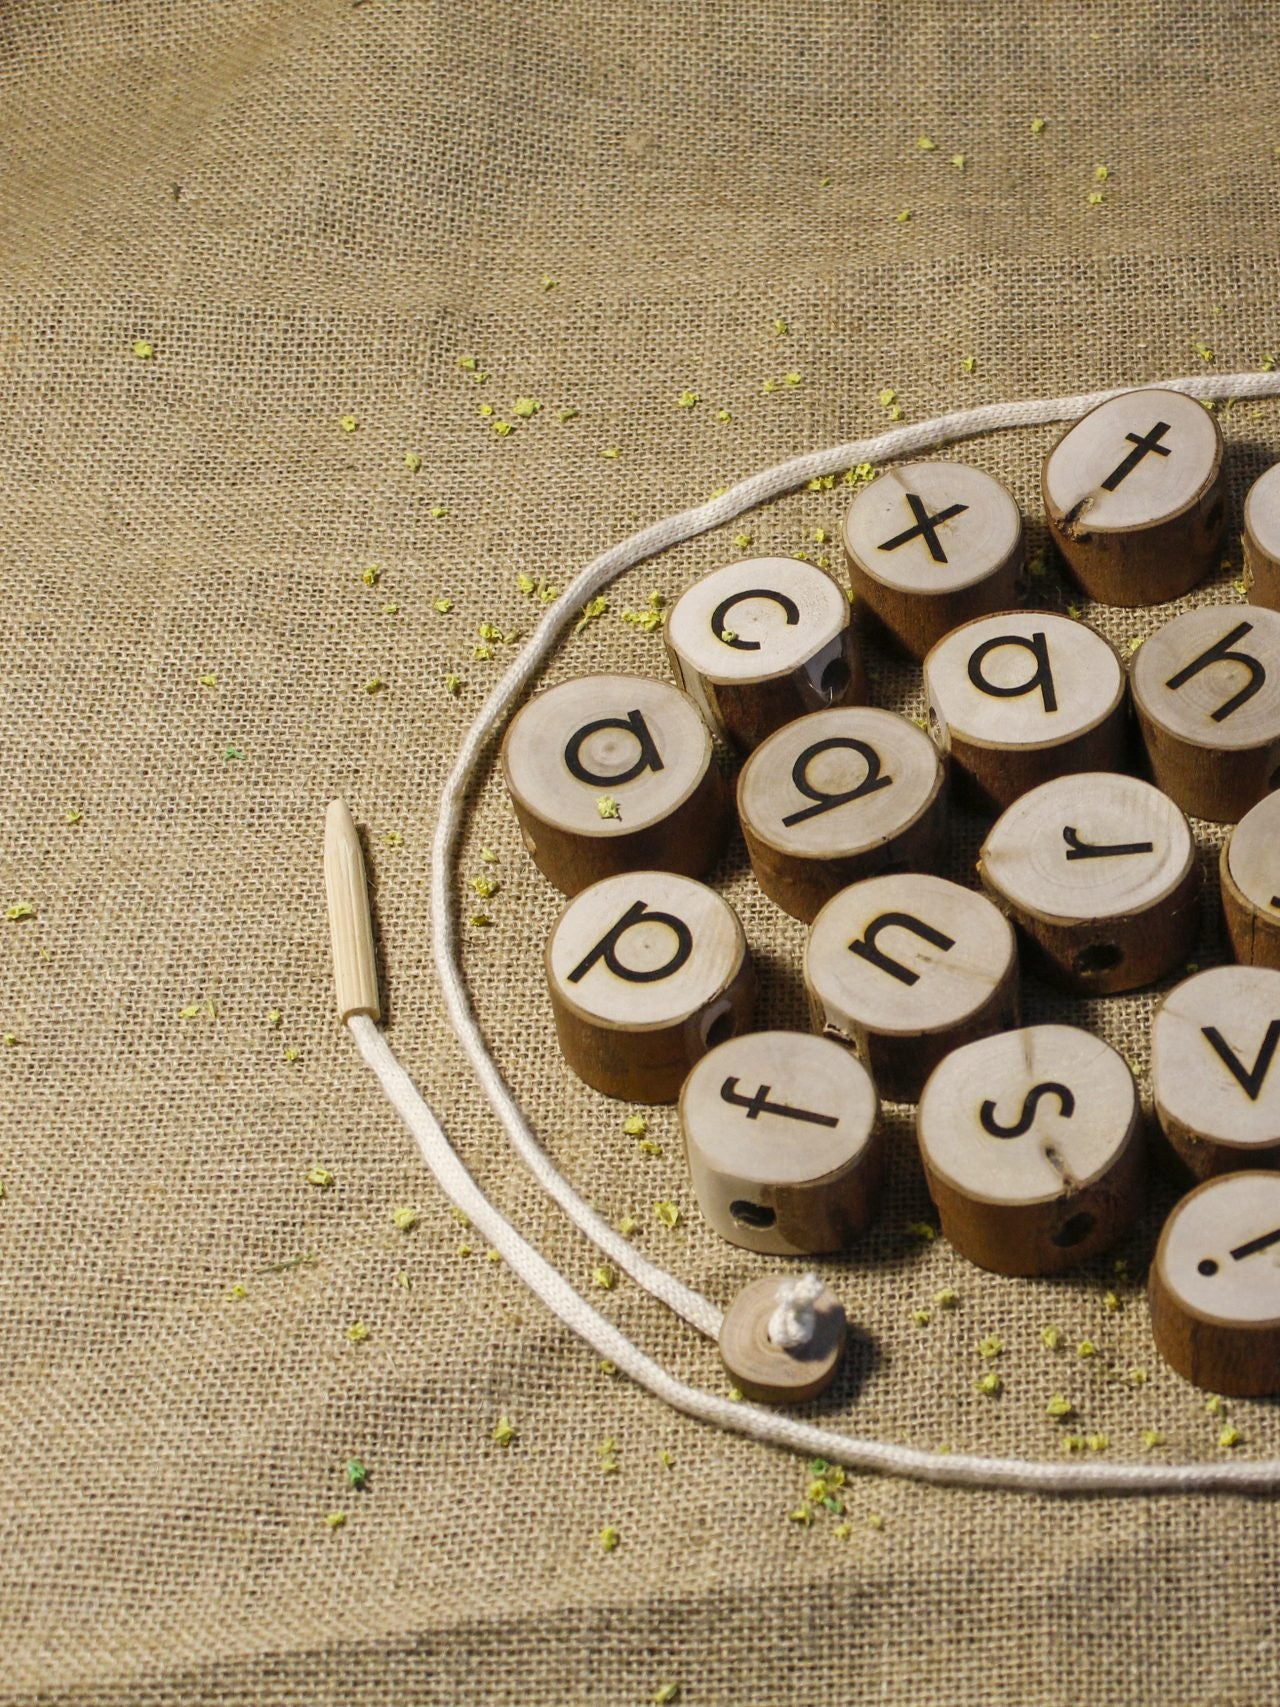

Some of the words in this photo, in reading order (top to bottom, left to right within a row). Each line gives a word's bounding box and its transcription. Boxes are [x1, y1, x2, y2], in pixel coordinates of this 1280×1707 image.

[1100, 421, 1172, 492] t
[1165, 621, 1266, 723] h
[564, 709, 665, 788] a
[1062, 826, 1153, 861] r
[720, 1076, 839, 1128] f
[979, 1082, 1075, 1139] s
